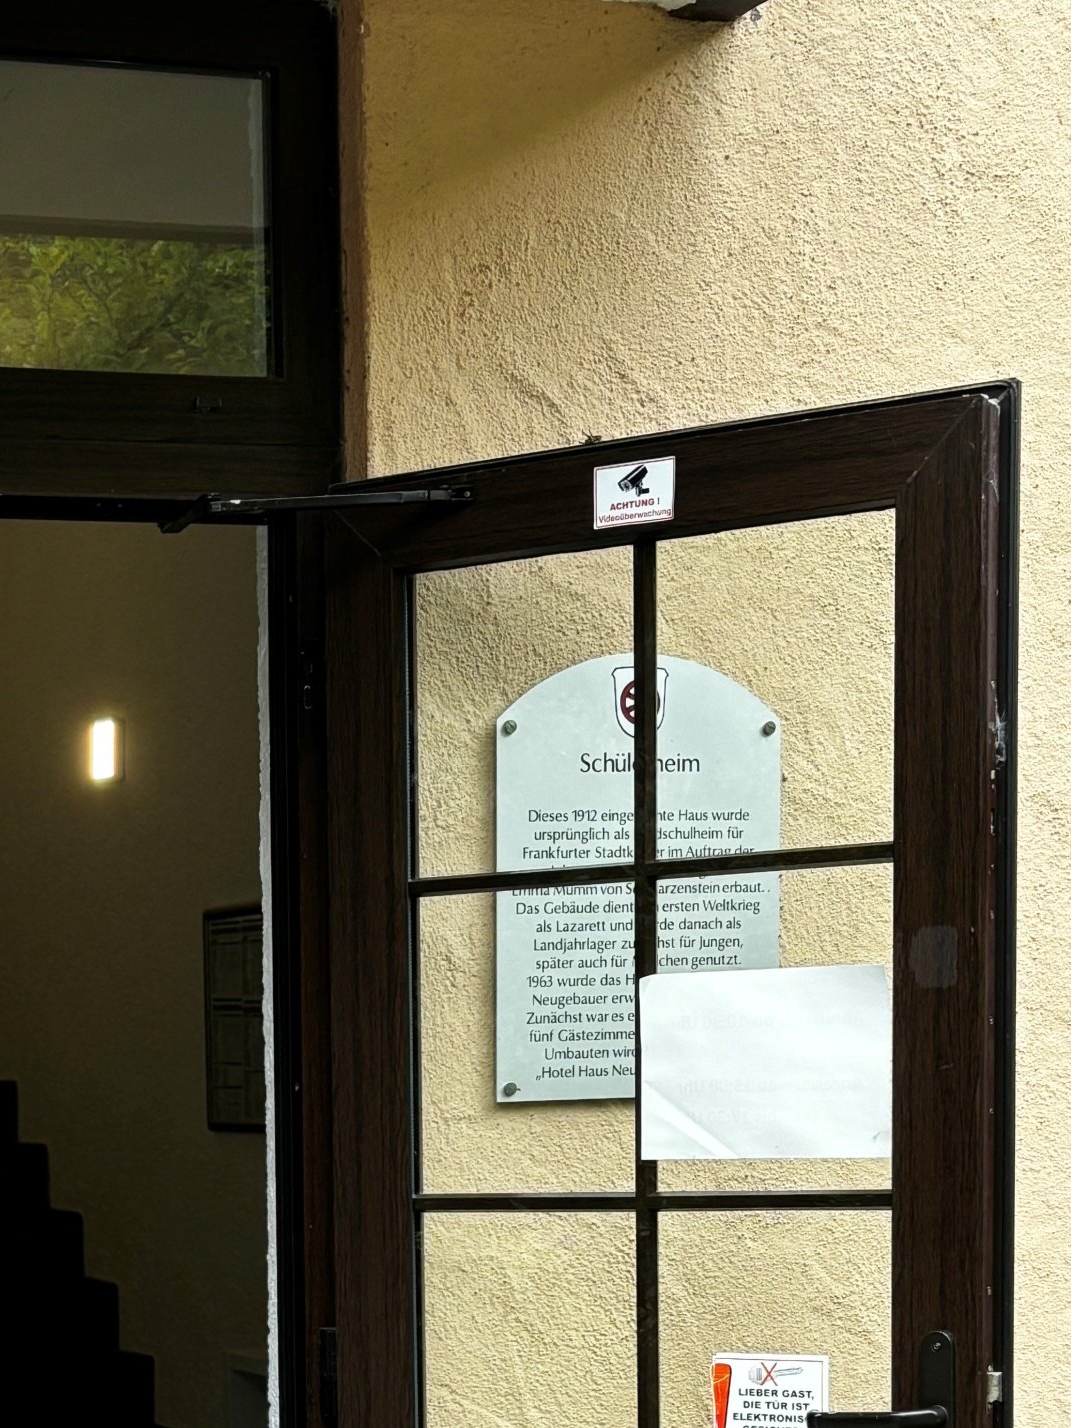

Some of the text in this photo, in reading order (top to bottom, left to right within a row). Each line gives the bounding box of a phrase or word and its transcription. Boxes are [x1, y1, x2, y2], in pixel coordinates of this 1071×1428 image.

[610, 498, 654, 511] ACHTUNG
[599, 508, 671, 523] Videoüberwachung
[580, 752, 700, 773] Schüleim
[528, 808, 750, 826] Dieses 1912 eingete Haus wurde
[534, 826, 744, 844] ursprünglich als dschulheim für
[522, 846, 591, 860] Frankfurter
[595, 846, 666, 859] Stadtkr
[668, 846, 683, 859] im
[553, 886, 598, 896] Mumm
[601, 885, 622, 895] von
[626, 882, 720, 894] Sarzenstein
[516, 902, 539, 915] Das
[544, 901, 599, 914] Gebäude
[603, 900, 634, 913] dient
[662, 900, 699, 912] ersten
[703, 899, 760, 915] Weltkrieg
[536, 920, 552, 933] als
[556, 920, 606, 932] Lazarett
[611, 918, 633, 931] und
[679, 917, 722, 930] danach
[727, 917, 741, 929] als
[534, 936, 743, 953] Landjahrlager zuhst für Jungen,
[536, 956, 575, 973] später
[578, 956, 607, 968] auch
[611, 955, 627, 968] für
[691, 955, 742, 969] genutzt.
[527, 974, 635, 988] 1963 wurde das H
[533, 994, 635, 1009] Neugebauer erw
[527, 1012, 635, 1025] Zunächst war es e
[529, 1029, 635, 1043] fünf Gästezimme
[545, 1046, 635, 1060] Umbauten wir
[536, 1064, 635, 1080] „Hotel Haus Neu
[739, 1388, 814, 1400] LIEBER GAST,
[743, 1400, 810, 1411] DIE TÜR IST
[733, 1412, 807, 1423] ELEKTRONIS
